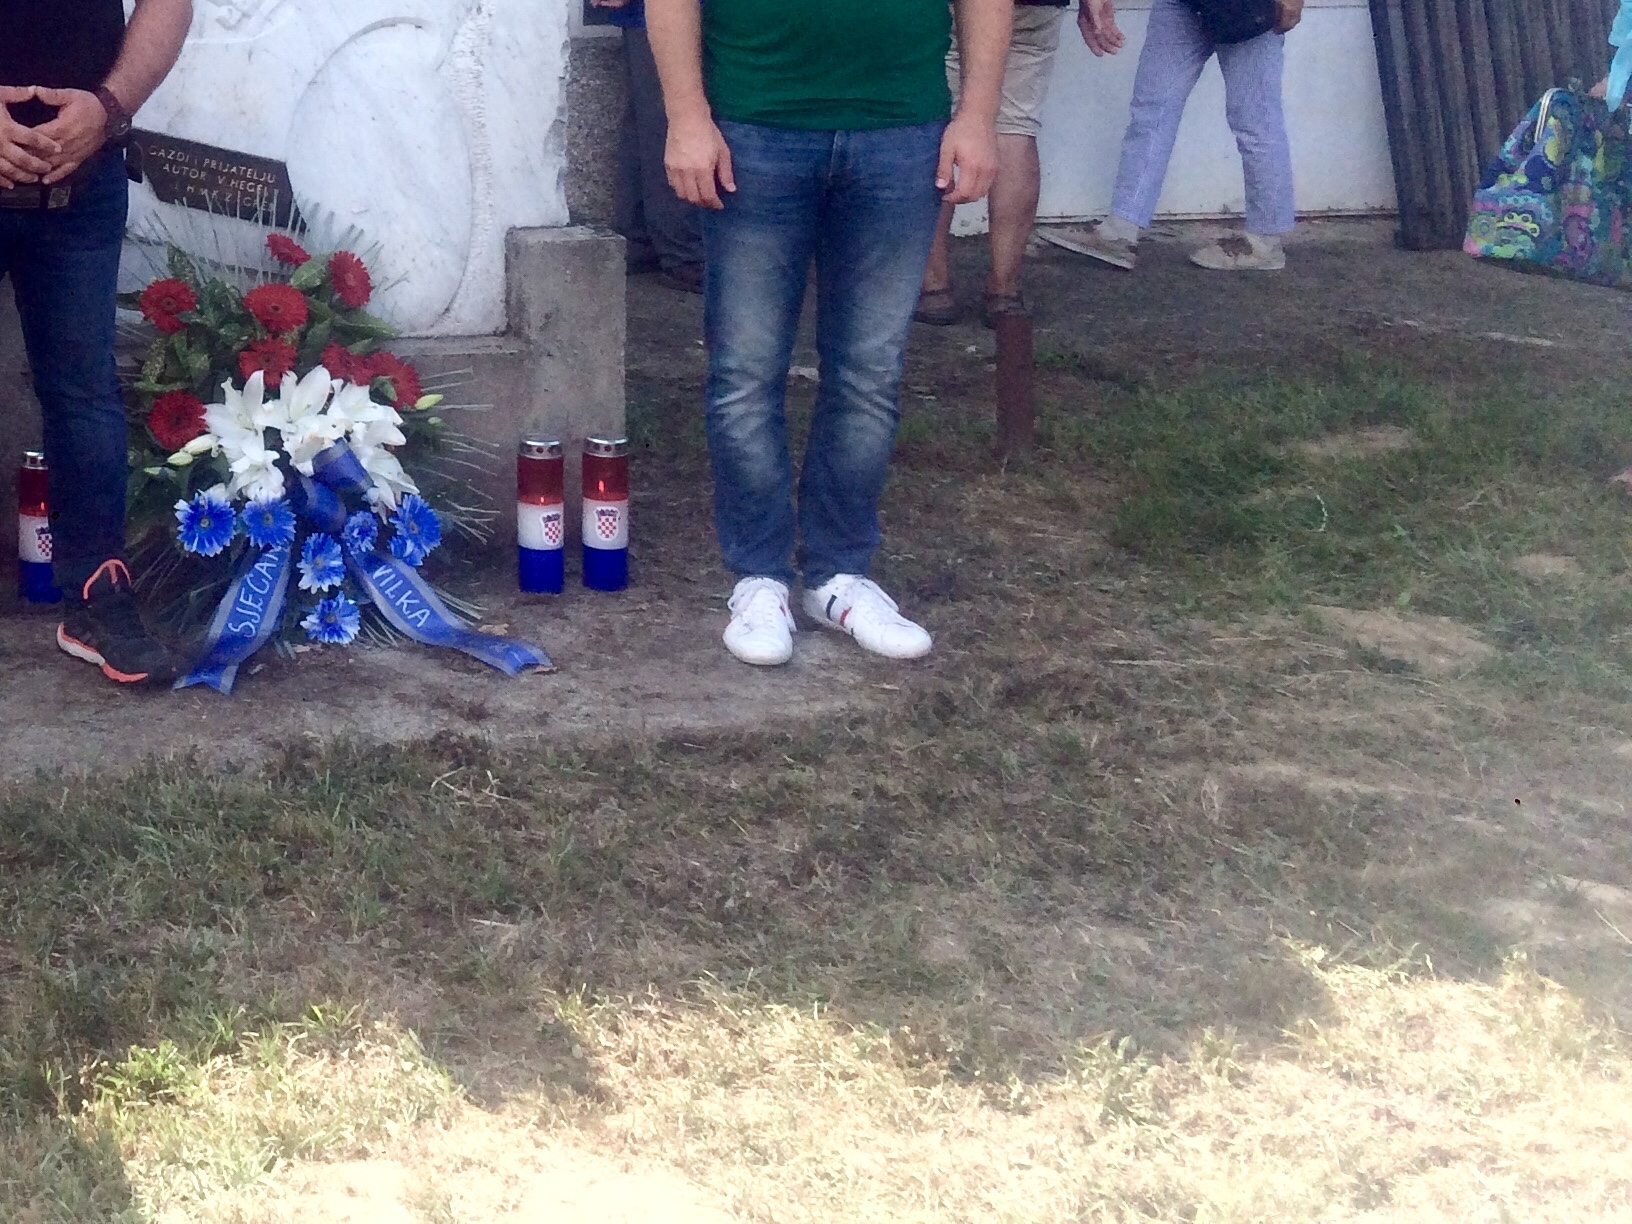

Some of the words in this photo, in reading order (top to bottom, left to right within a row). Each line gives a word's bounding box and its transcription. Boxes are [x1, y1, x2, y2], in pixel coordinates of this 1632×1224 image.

[163, 163, 207, 181] AUTOR
[203, 158, 277, 184] PRIJATELJU
[373, 565, 431, 628] VILKA
